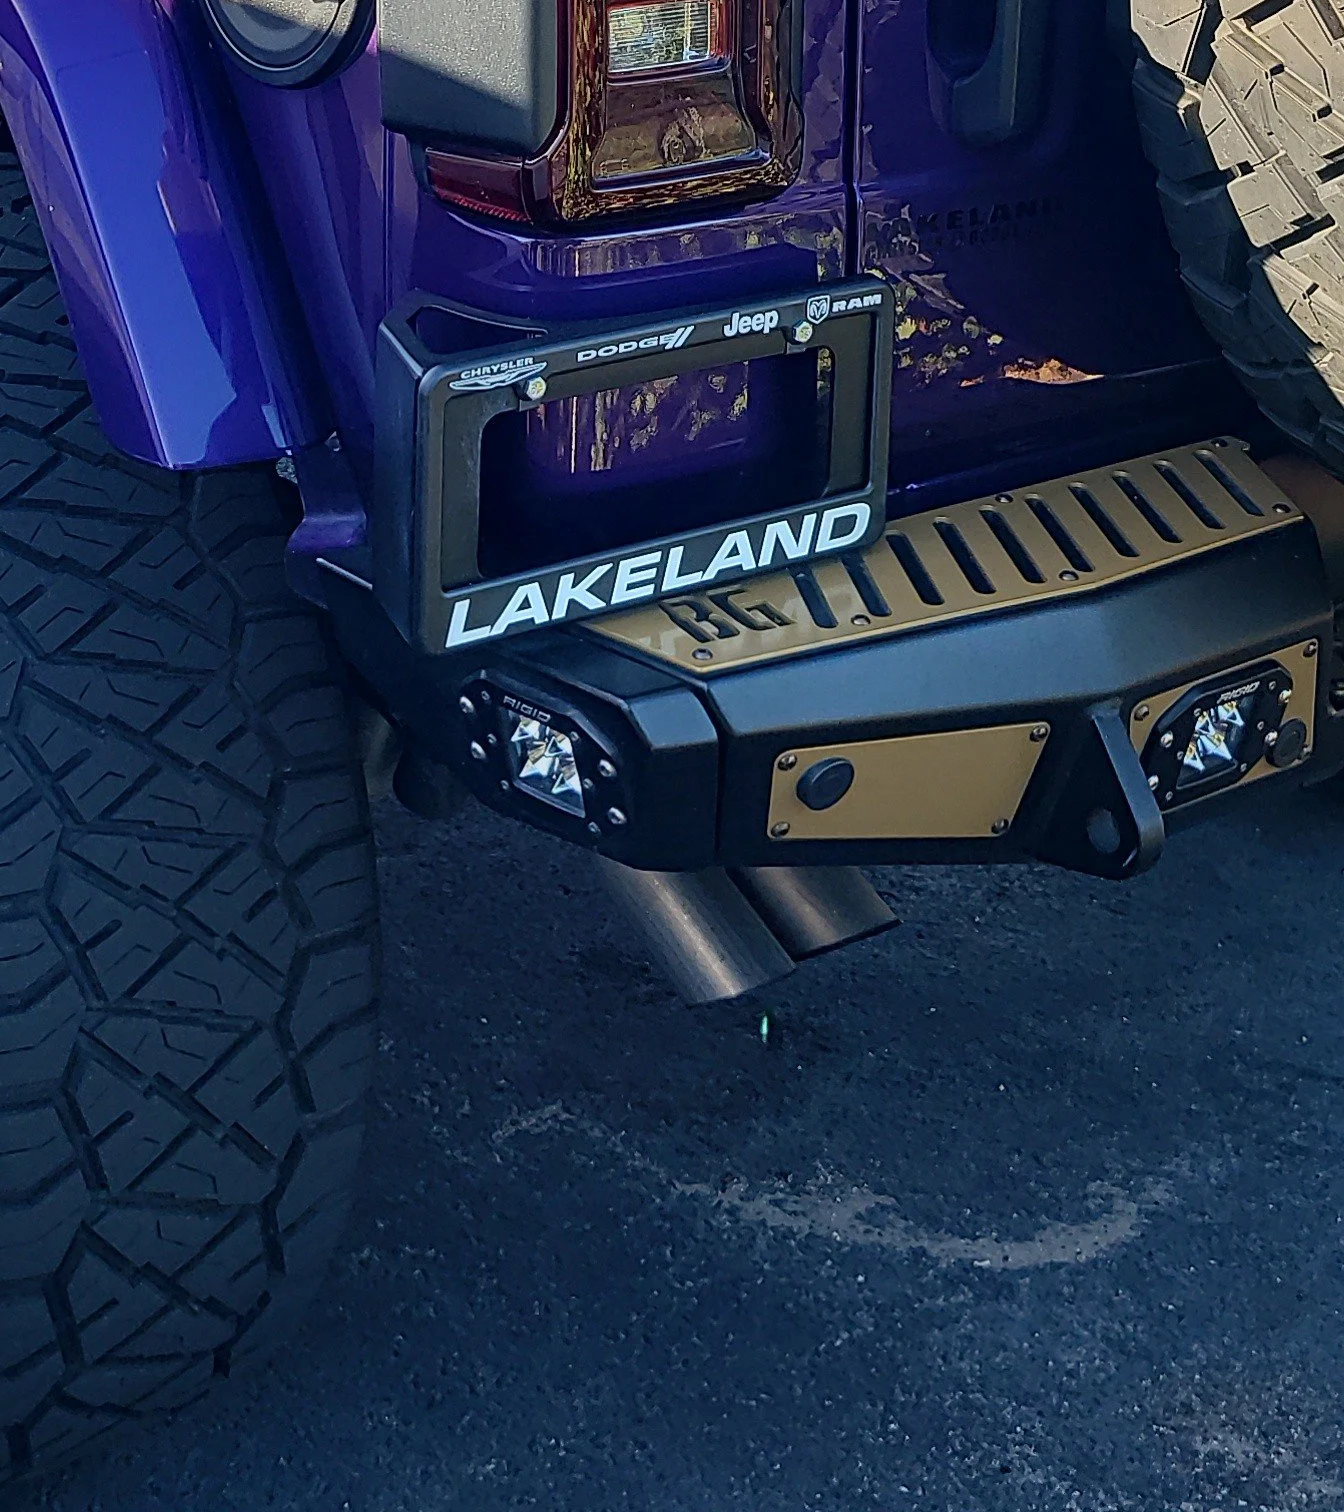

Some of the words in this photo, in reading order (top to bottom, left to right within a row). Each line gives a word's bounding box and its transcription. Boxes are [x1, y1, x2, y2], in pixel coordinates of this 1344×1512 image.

[832, 293, 882, 313] RAM
[723, 309, 779, 337] Jeep
[577, 332, 680, 363] DODGE
[460, 357, 534, 380] CHRYSLER
[444, 502, 872, 649] LAKELAND
[502, 695, 551, 723] RIGID
